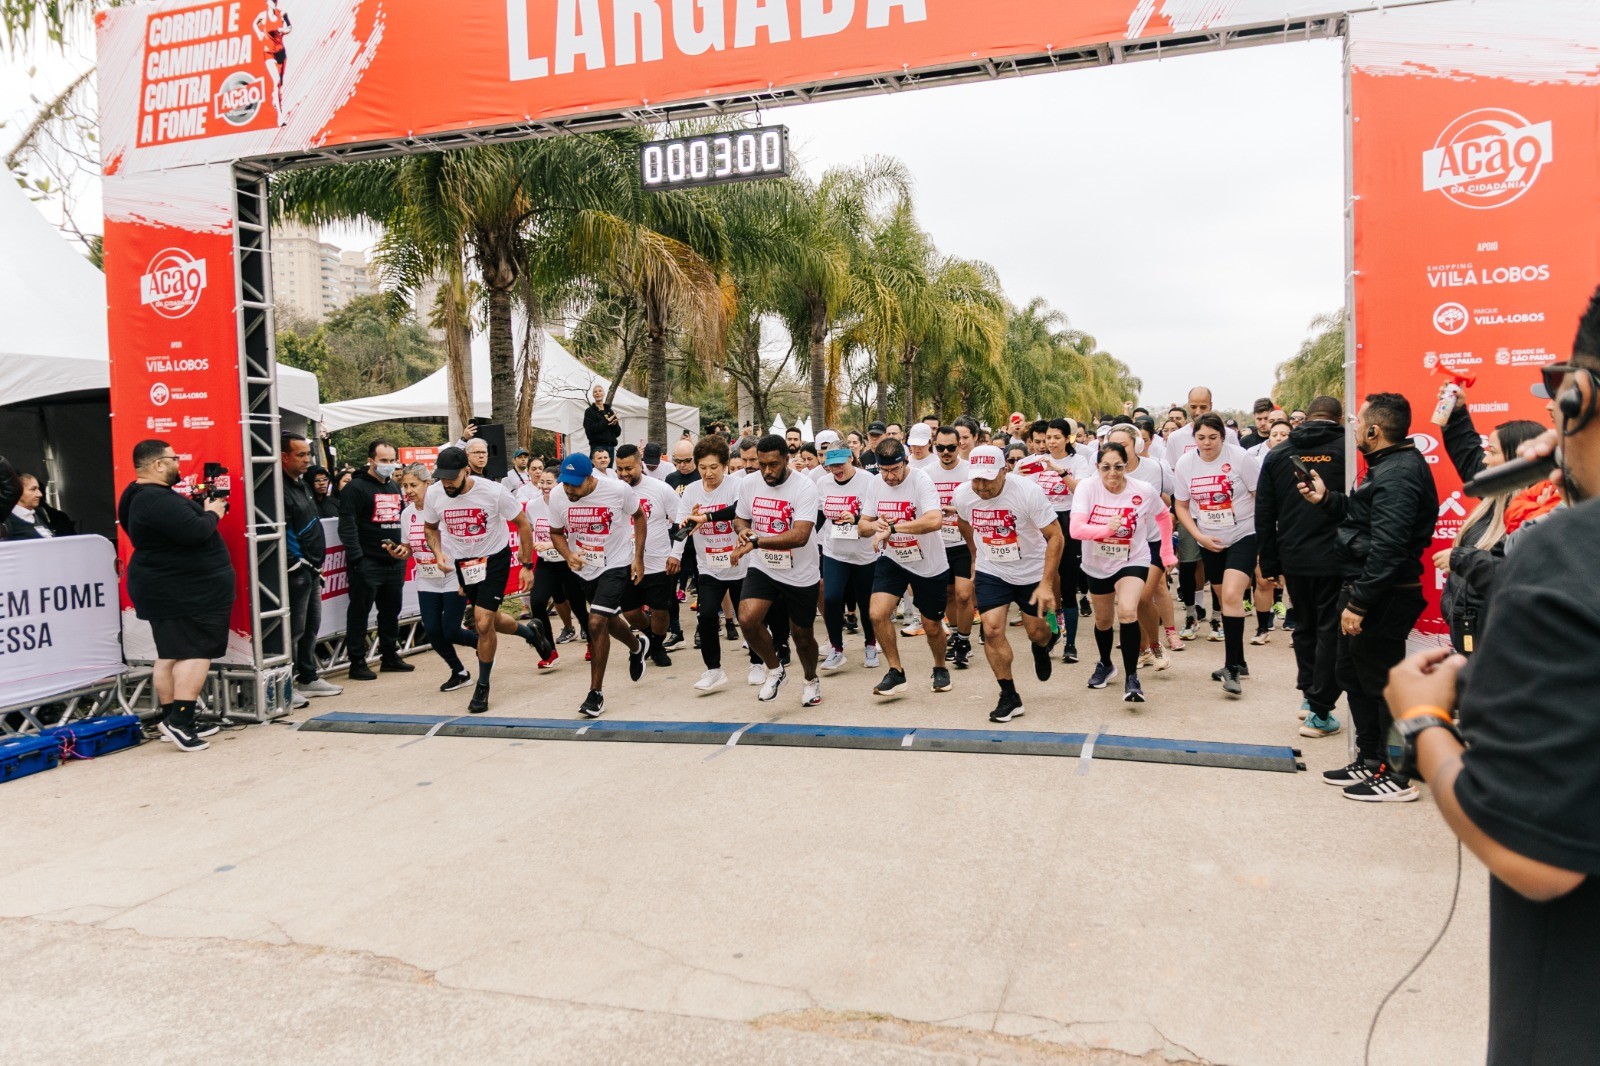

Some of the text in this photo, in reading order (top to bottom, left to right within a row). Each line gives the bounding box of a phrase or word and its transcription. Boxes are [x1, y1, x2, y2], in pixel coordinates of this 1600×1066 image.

[149, 2, 241, 47] CORRIDA E
[507, 0, 927, 82] LARGA
[147, 34, 252, 81] CAMINHADA
[144, 74, 211, 112] CONTRA
[140, 105, 208, 143] A FOME
[1451, 180, 1527, 195] DA CIDADANIA
[1476, 241, 1499, 252] APOIO
[1426, 262, 1474, 272] SHOPPING
[1426, 264, 1551, 288] VILLA LOBOS
[1474, 312, 1546, 326] VILLA-LOBOS
[1456, 356, 1483, 365] PAULO
[1511, 353, 1557, 362] SÃO PAULO
[146, 358, 210, 373] VILLA LOBOS
[1468, 401, 1509, 414] PATROCÍNIO
[970, 455, 996, 465] SANTIAGO
[1300, 454, 1332, 464] ODUÇÃO
[568, 507, 599, 516] CORRIDA E
[1207, 512, 1225, 520] 5801
[1431, 526, 1461, 539] ASS
[990, 547, 1011, 555] 5705
[1100, 544, 1121, 553] 6319
[322, 550, 346, 573] RRI
[711, 554, 729, 562] 7425
[764, 552, 784, 562] 6082
[39, 582, 106, 614] FOME
